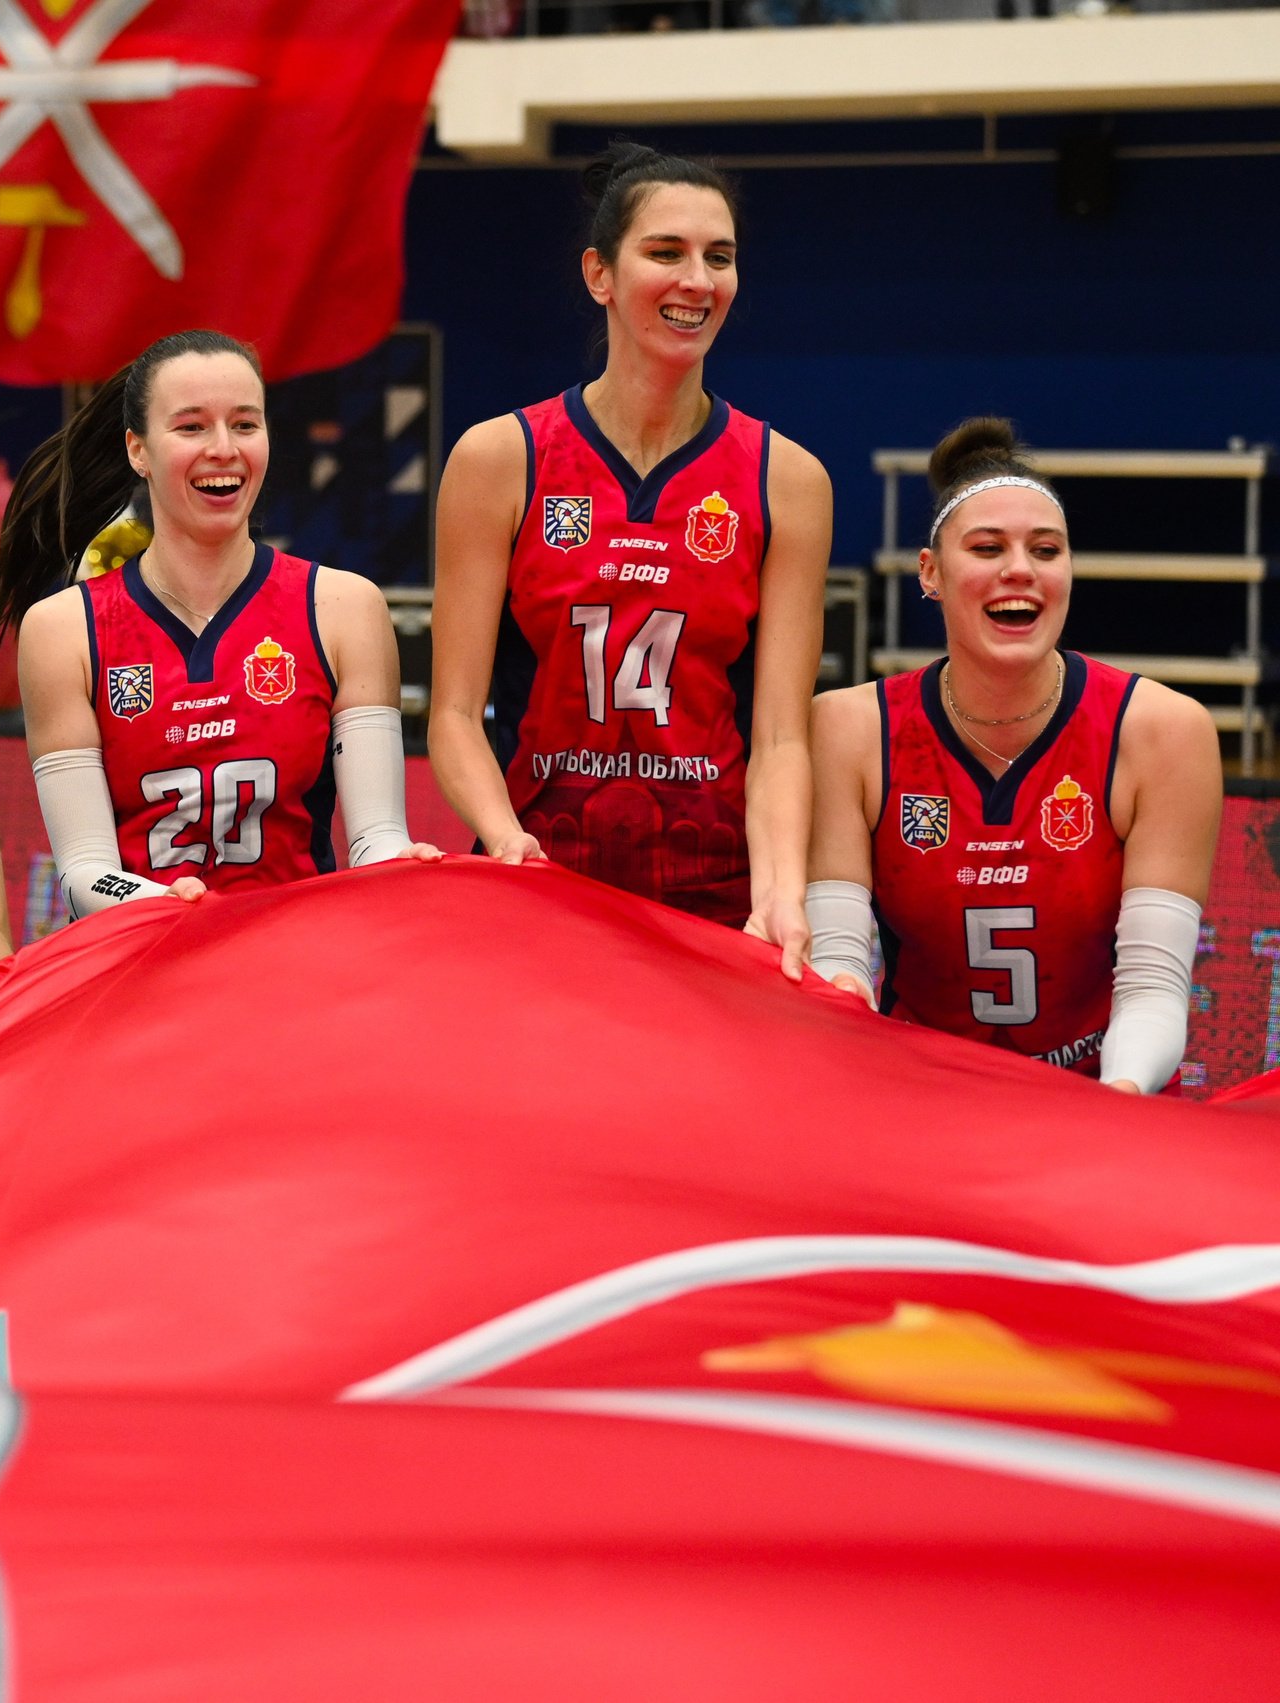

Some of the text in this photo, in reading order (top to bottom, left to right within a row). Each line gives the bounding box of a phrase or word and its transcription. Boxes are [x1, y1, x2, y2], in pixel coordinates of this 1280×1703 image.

[608, 538, 669, 552] ENSEN
[618, 563, 671, 585] ВФВ
[571, 605, 686, 727] 14
[171, 694, 231, 711] ENSEN
[186, 718, 237, 743] ВФВ
[139, 758, 277, 871] 20
[965, 839, 1025, 852] ENSEN
[977, 865, 1029, 885] ВФВ
[964, 906, 1038, 1025] 5
